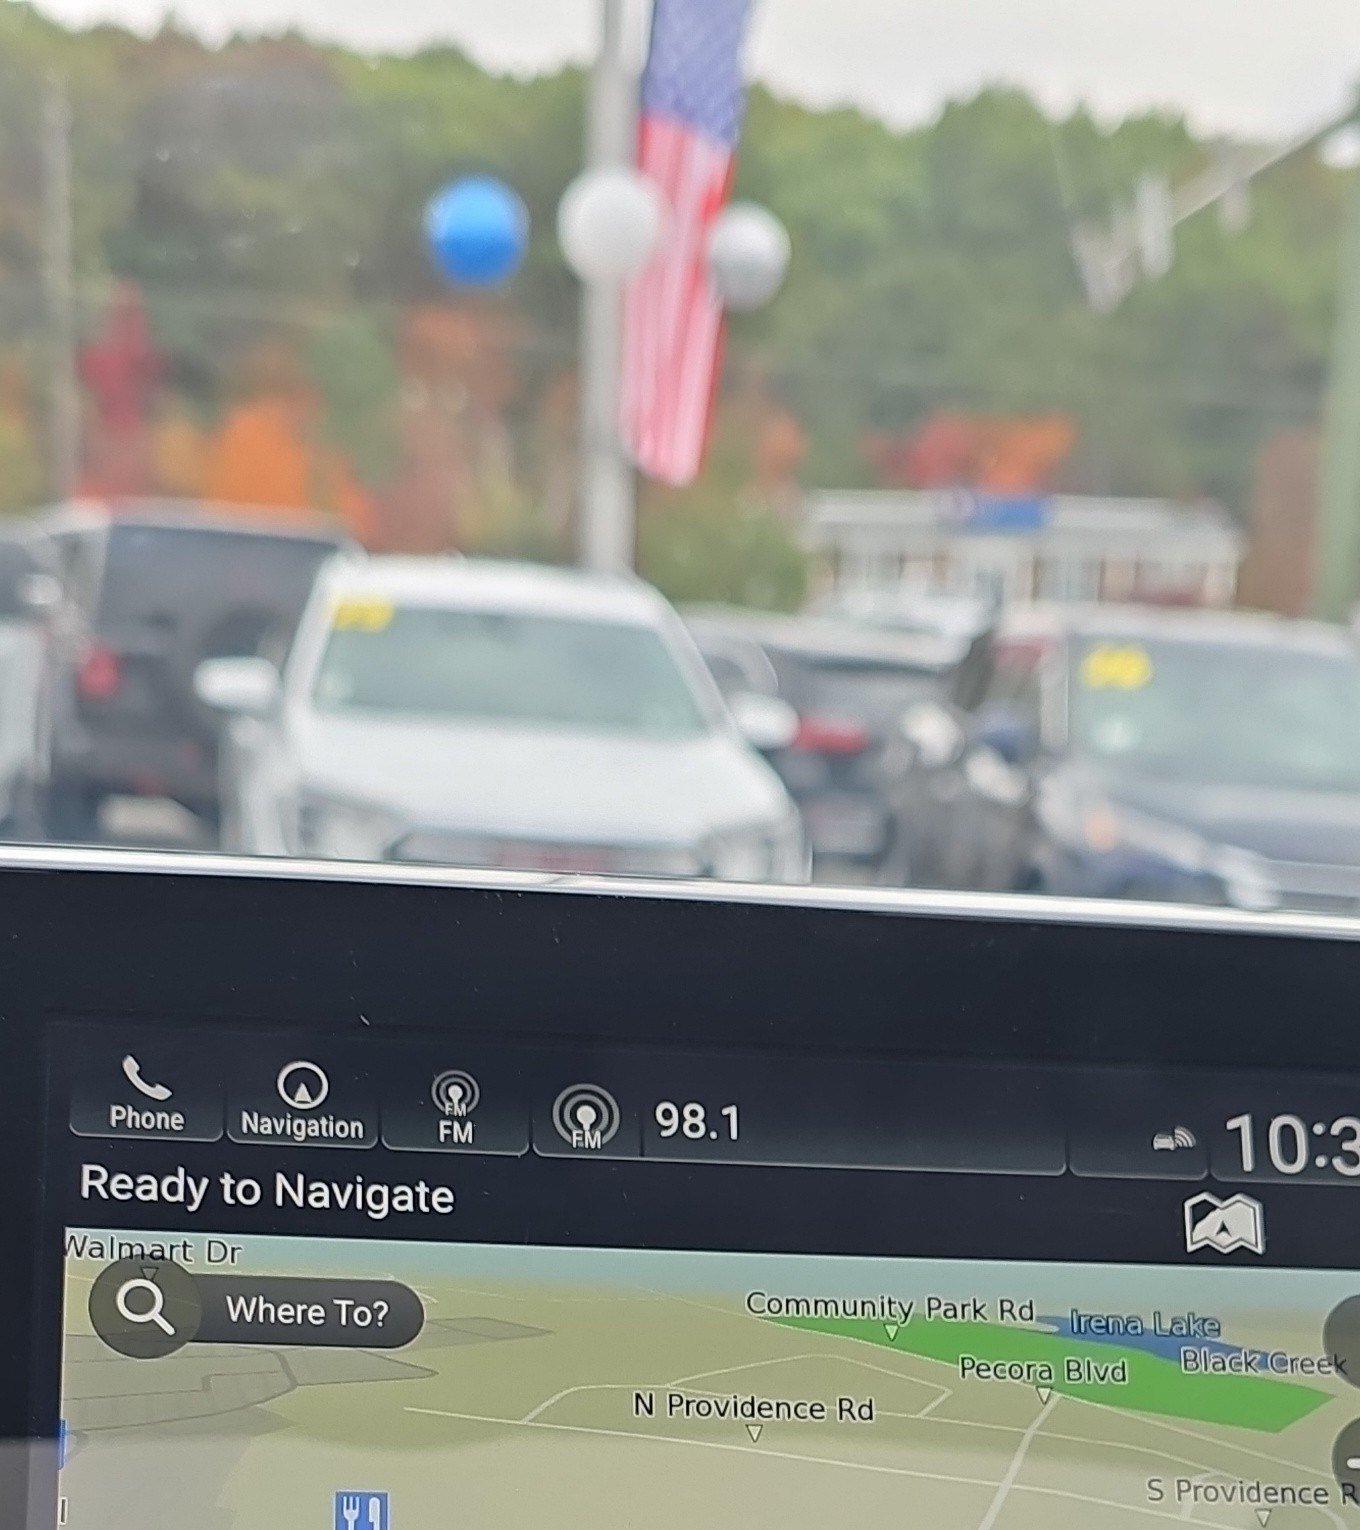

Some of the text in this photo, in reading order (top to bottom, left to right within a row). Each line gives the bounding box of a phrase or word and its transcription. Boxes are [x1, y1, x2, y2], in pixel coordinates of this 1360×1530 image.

[110, 1104, 185, 1132] Phone
[444, 1103, 468, 1117] FM
[653, 1101, 741, 1141] 98.1
[241, 1112, 365, 1144] Navigation
[439, 1120, 474, 1145] FM
[571, 1129, 602, 1150] FM
[80, 1163, 456, 1220] Ready to Navigate
[65, 1233, 243, 1265] Walmart Dr
[226, 1295, 390, 1330] Where To?
[746, 1292, 1036, 1324] Community Park Rd
[1070, 1310, 1222, 1339] Irena Lake
[959, 1357, 1128, 1385] Pecora Blvd
[1181, 1348, 1348, 1378] Black Creek
[634, 1393, 875, 1422] N Providence Rd
[1147, 1477, 1166, 1503] S
[1176, 1478, 1331, 1506] Providence
